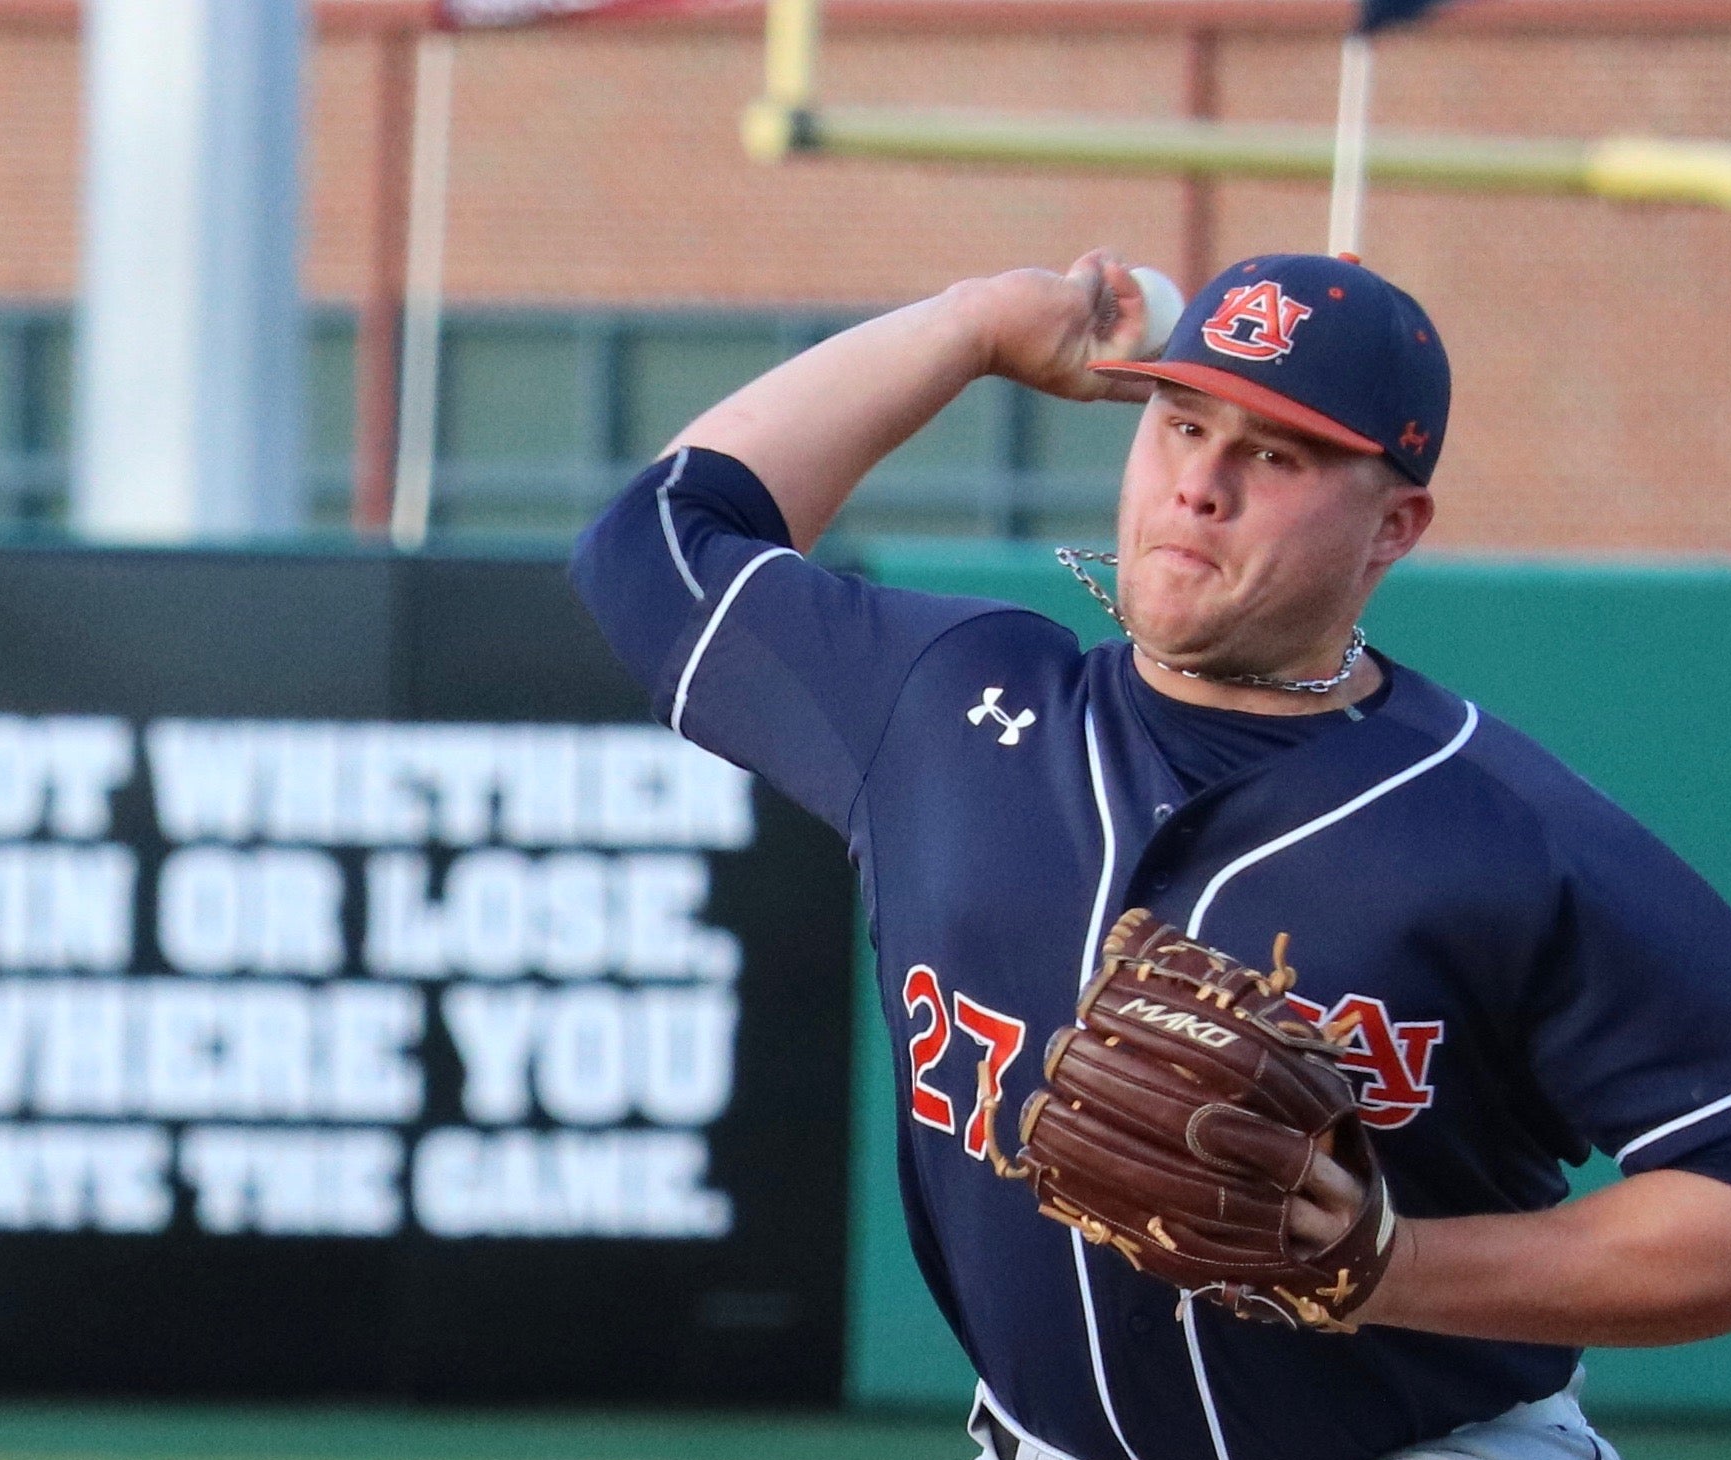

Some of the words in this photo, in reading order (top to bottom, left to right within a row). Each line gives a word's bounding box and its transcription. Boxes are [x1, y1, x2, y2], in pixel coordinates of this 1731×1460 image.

[146, 719, 754, 849] WHETHER
[158, 848, 346, 975] OR
[366, 852, 743, 981] LOSE.
[441, 983, 740, 1127] YOU
[903, 964, 1026, 1161] 27
[1117, 998, 1241, 1048] MAKO
[174, 1123, 404, 1235] THE
